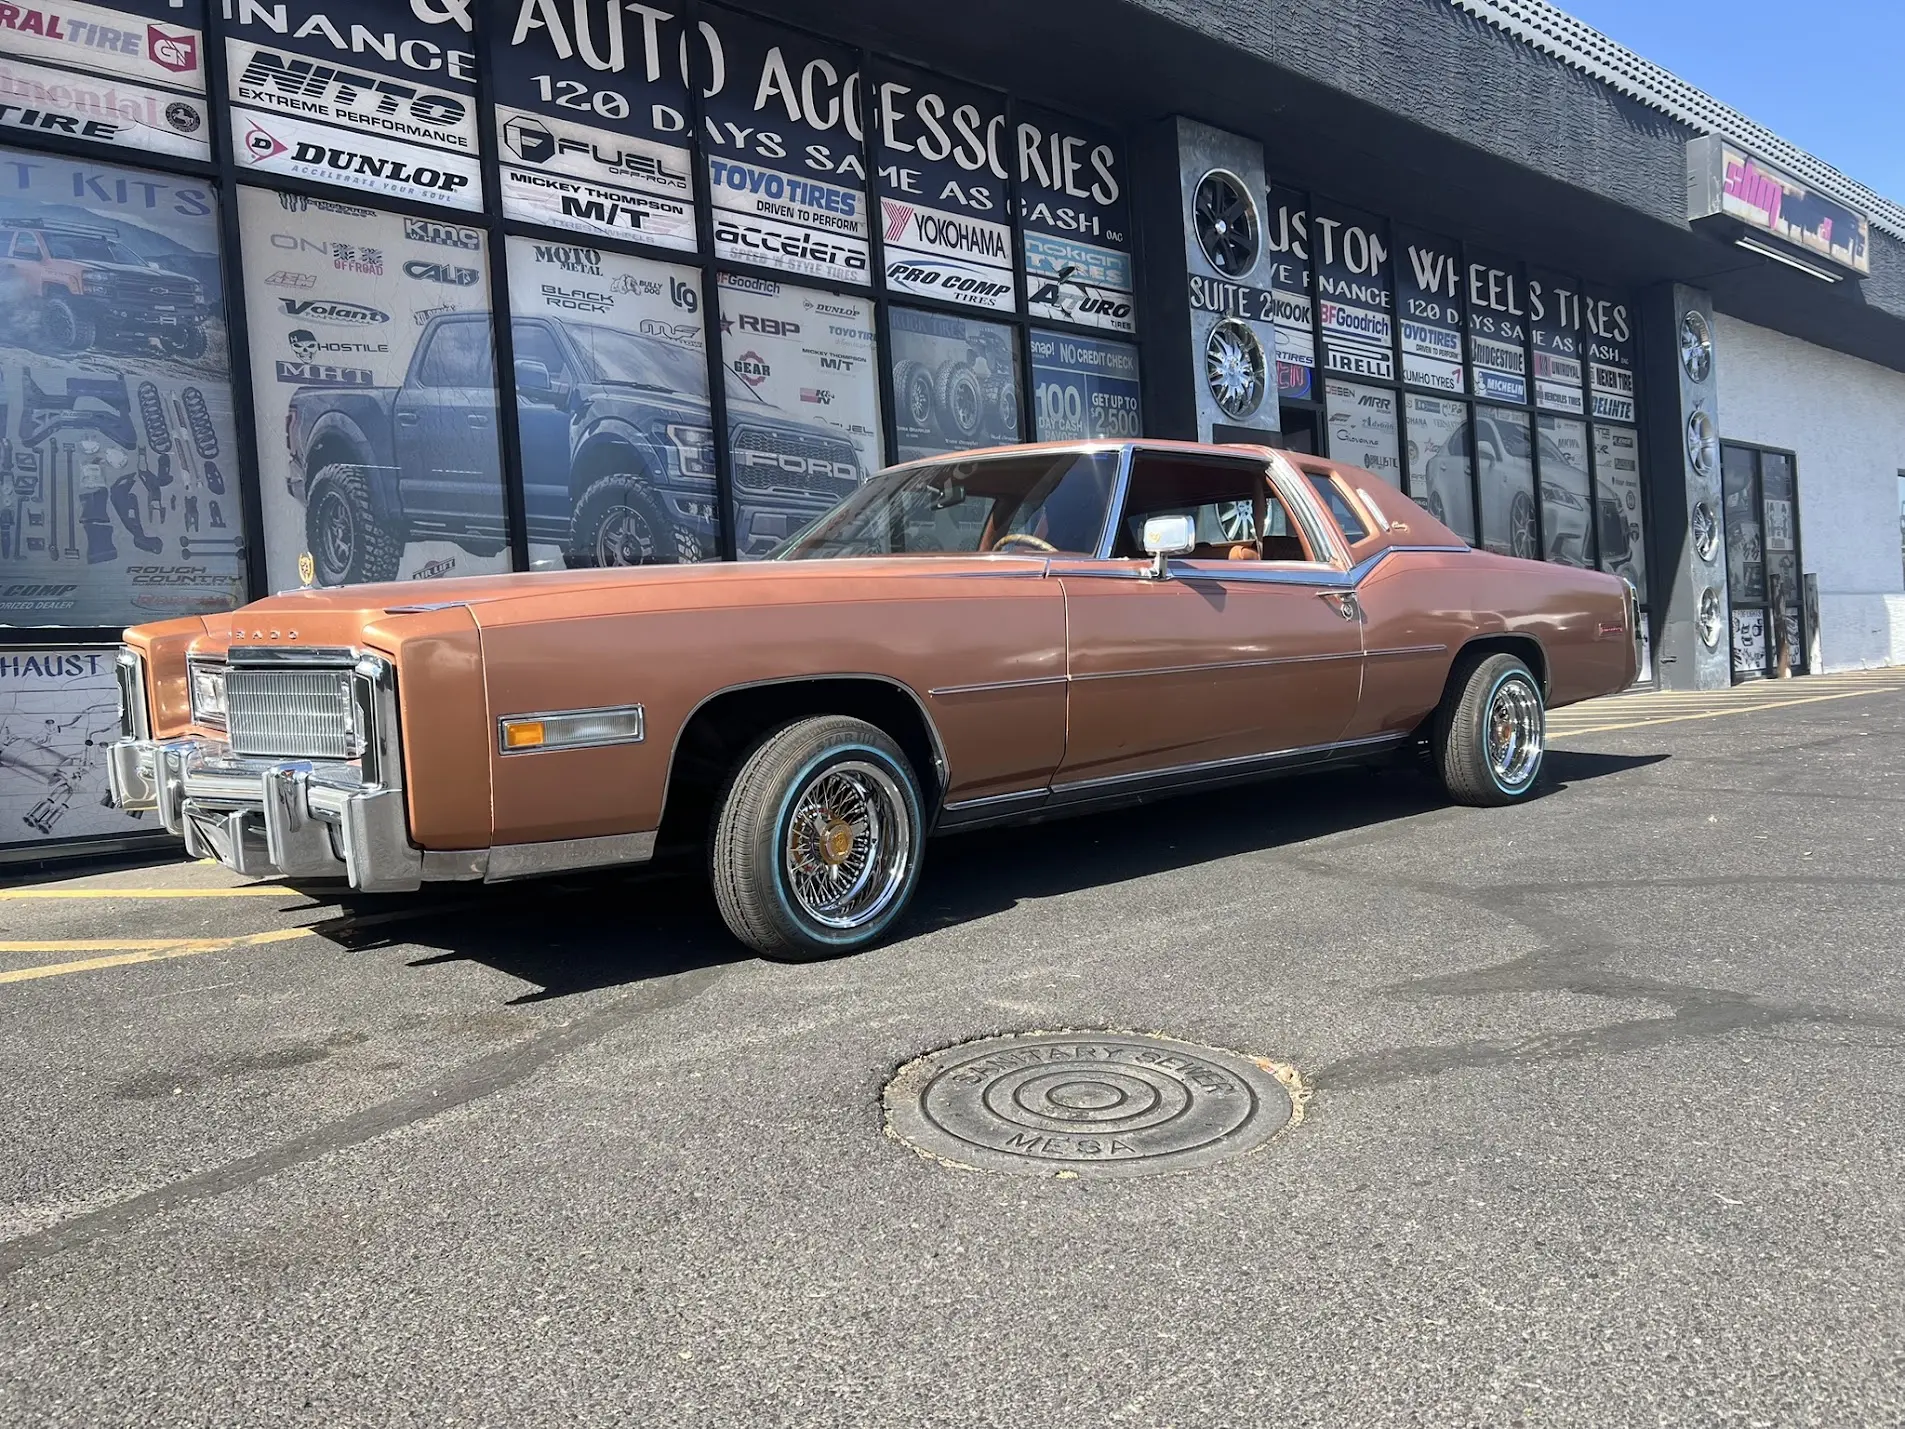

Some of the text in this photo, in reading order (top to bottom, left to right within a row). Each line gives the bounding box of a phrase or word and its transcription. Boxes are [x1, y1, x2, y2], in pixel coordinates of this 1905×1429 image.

[240, 51, 466, 127] NITTO
[238, 87, 468, 148] EXTREME PERFORMANCE
[530, 75, 630, 119] 120
[939, 180, 994, 211] AS
[290, 141, 469, 193] DUNLOP
[557, 138, 686, 182] FUEL
[291, 164, 452, 202] ACCELERATE YOUR SOUL
[608, 166, 687, 190] OFF-ROAD
[711, 160, 857, 217] TOYO TIRES
[72, 171, 212, 217] KITS
[510, 172, 684, 215] MICKEY THOMPSON
[561, 196, 650, 230] M/T
[756, 199, 858, 233] DRIVEN TO PERFORM
[714, 221, 867, 271] accelera
[913, 212, 1007, 259] YOKOHAMA
[532, 245, 601, 266] MOTO
[333, 259, 384, 277] OFFROAD
[559, 261, 604, 277] METAL
[826, 264, 858, 282] TIRES
[638, 279, 663, 290] BULLY
[886, 263, 1012, 298] PRO COMP
[541, 284, 615, 304] BLACK
[546, 297, 606, 314] ROCK
[953, 291, 997, 307] TIRES
[1190, 275, 1251, 318] SUITE
[278, 297, 382, 323] Volant
[815, 303, 861, 317] DUNLOP
[1321, 303, 1389, 336] BFGoodrich
[738, 313, 800, 337] RBP
[828, 325, 855, 339] TOYO
[1110, 319, 1132, 330] TIRES
[1407, 298, 1440, 320] 120
[1552, 335, 1574, 352] AS
[317, 342, 390, 353] HOSTILE
[1428, 328, 1458, 350] TIRES
[802, 347, 867, 363] MICKEY THOMPSON
[819, 357, 853, 371] M/T
[1060, 342, 1134, 370] NO CREDIT CHECK
[280, 362, 373, 384] MHT
[733, 360, 771, 377] GEAR
[1431, 374, 1455, 390] TYRES
[1487, 378, 1524, 396] MICHELIN
[1035, 382, 1081, 422] 100
[1092, 392, 1138, 411] GET UP TO
[1039, 416, 1083, 432] DAY CASH
[746, 452, 858, 481] FORD
[126, 566, 207, 574] ROUGH
[433, 558, 456, 573] LIFT
[132, 575, 243, 583] COUNTRY
[36, 601, 75, 610] DEALER
[952, 1046, 1236, 1095] SANITARY SEWER
[1005, 1131, 1136, 1155] MESA
